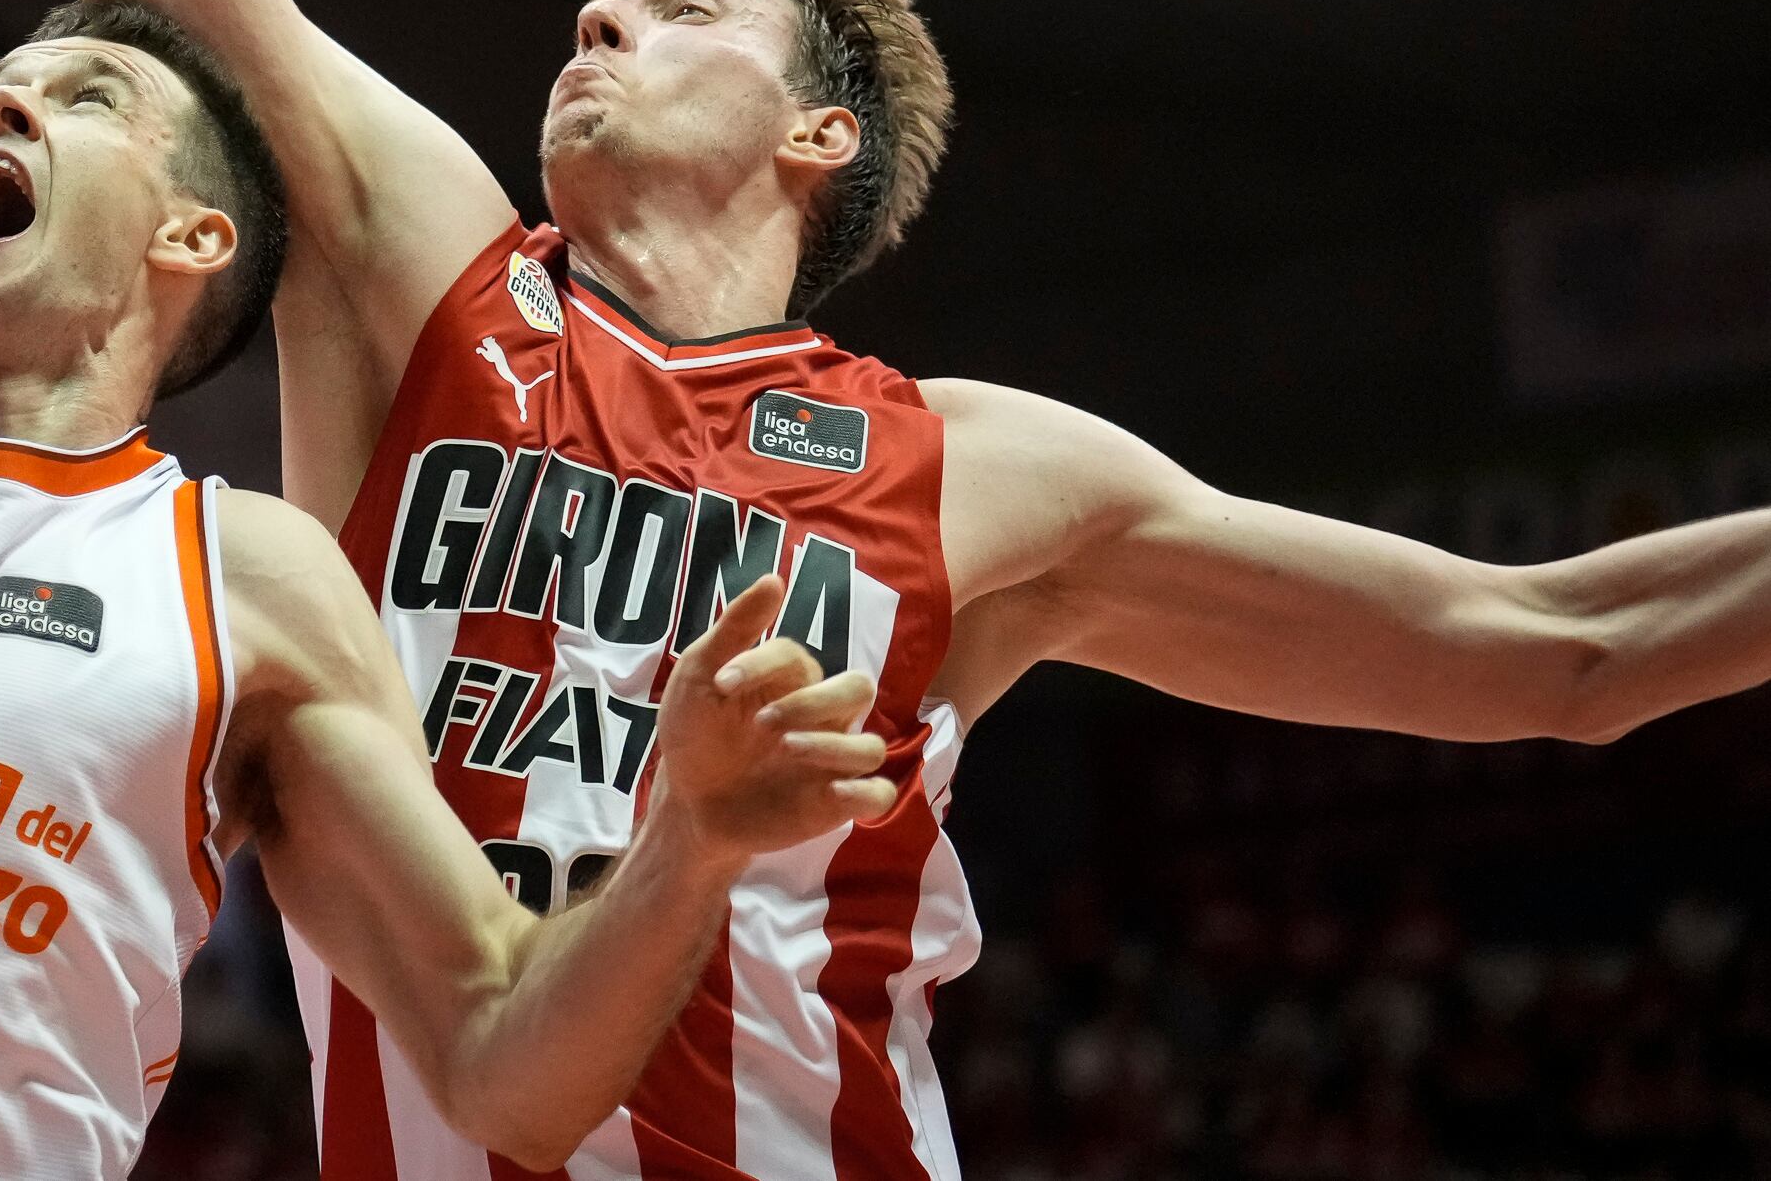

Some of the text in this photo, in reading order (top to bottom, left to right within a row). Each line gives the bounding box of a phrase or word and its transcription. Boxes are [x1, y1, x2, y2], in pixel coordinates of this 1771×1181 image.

[510, 277, 561, 332] GIRONA
[519, 268, 559, 313] BASQUET
[762, 432, 855, 462] endesa
[764, 411, 806, 437] liga
[390, 438, 857, 679] GIRONA
[0, 592, 45, 614] liga
[421, 655, 662, 799] FIAT
[15, 804, 93, 864] del
